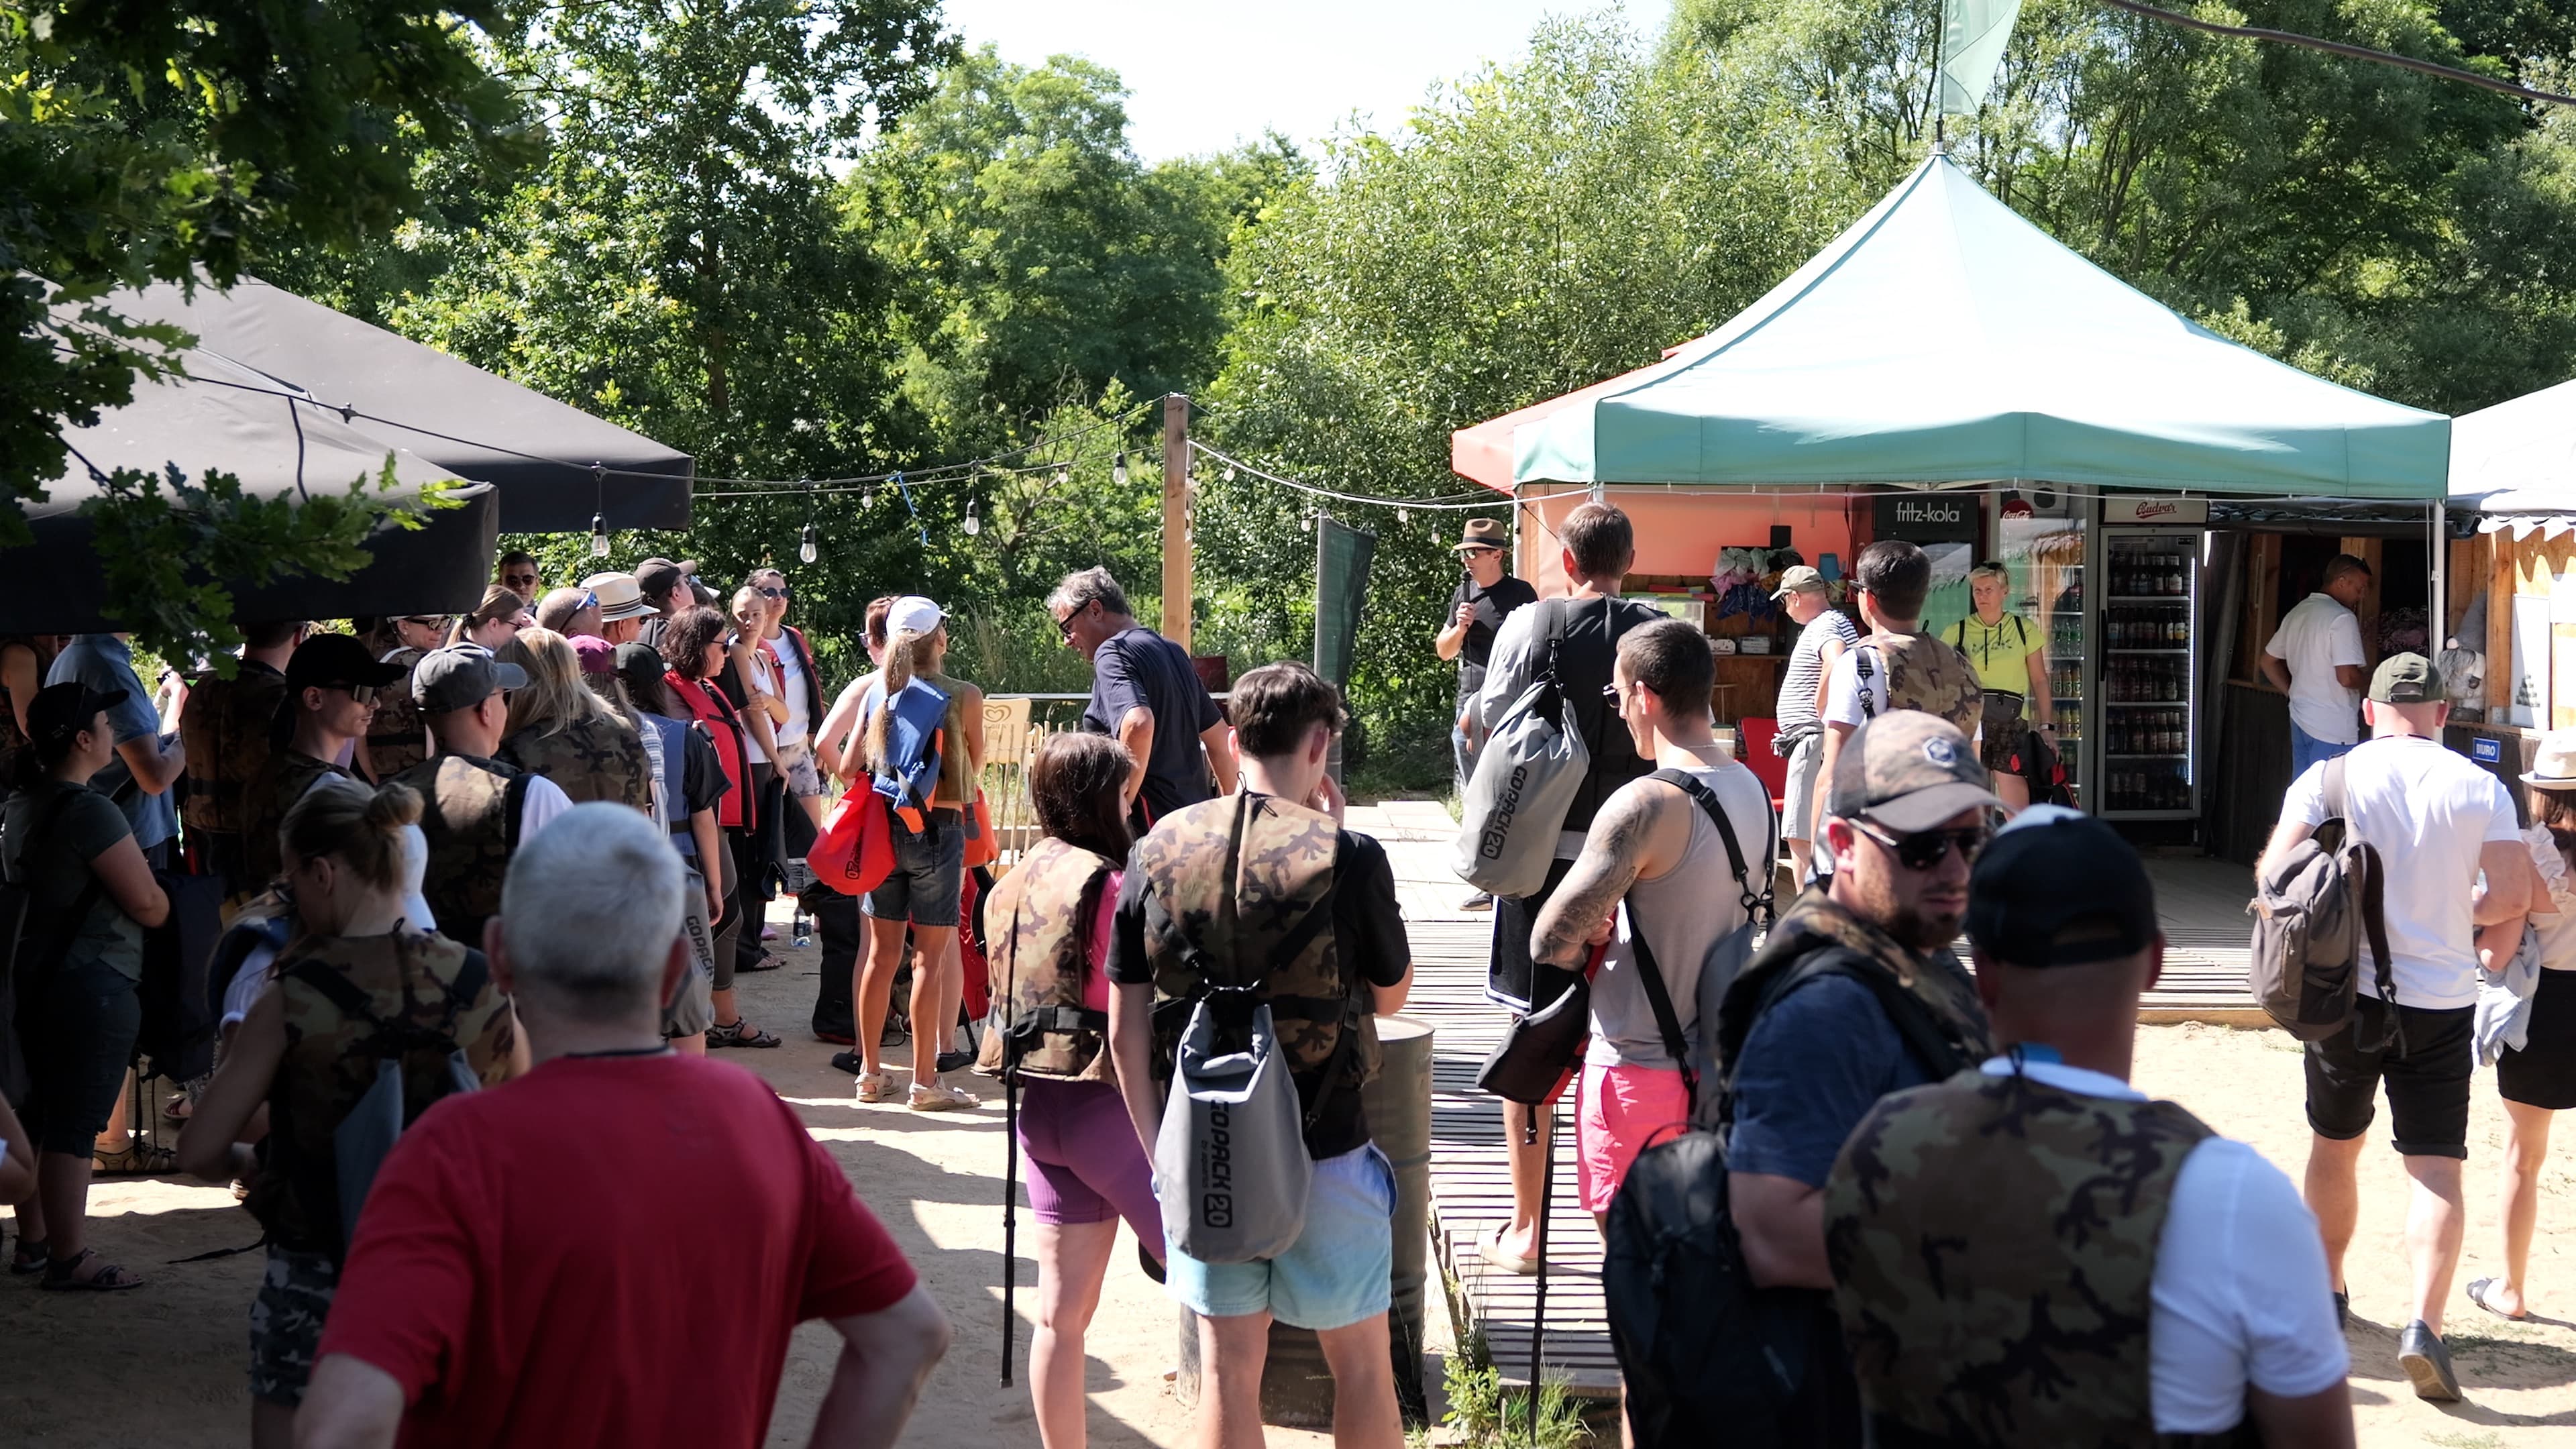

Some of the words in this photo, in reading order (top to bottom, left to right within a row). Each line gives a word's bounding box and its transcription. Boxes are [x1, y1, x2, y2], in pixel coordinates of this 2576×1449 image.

[1896, 501, 1960, 522] fritz-kola
[1495, 765, 1528, 836] GOPACK
[1484, 834, 1503, 857] 20
[1205, 1195, 1231, 1226] 20
